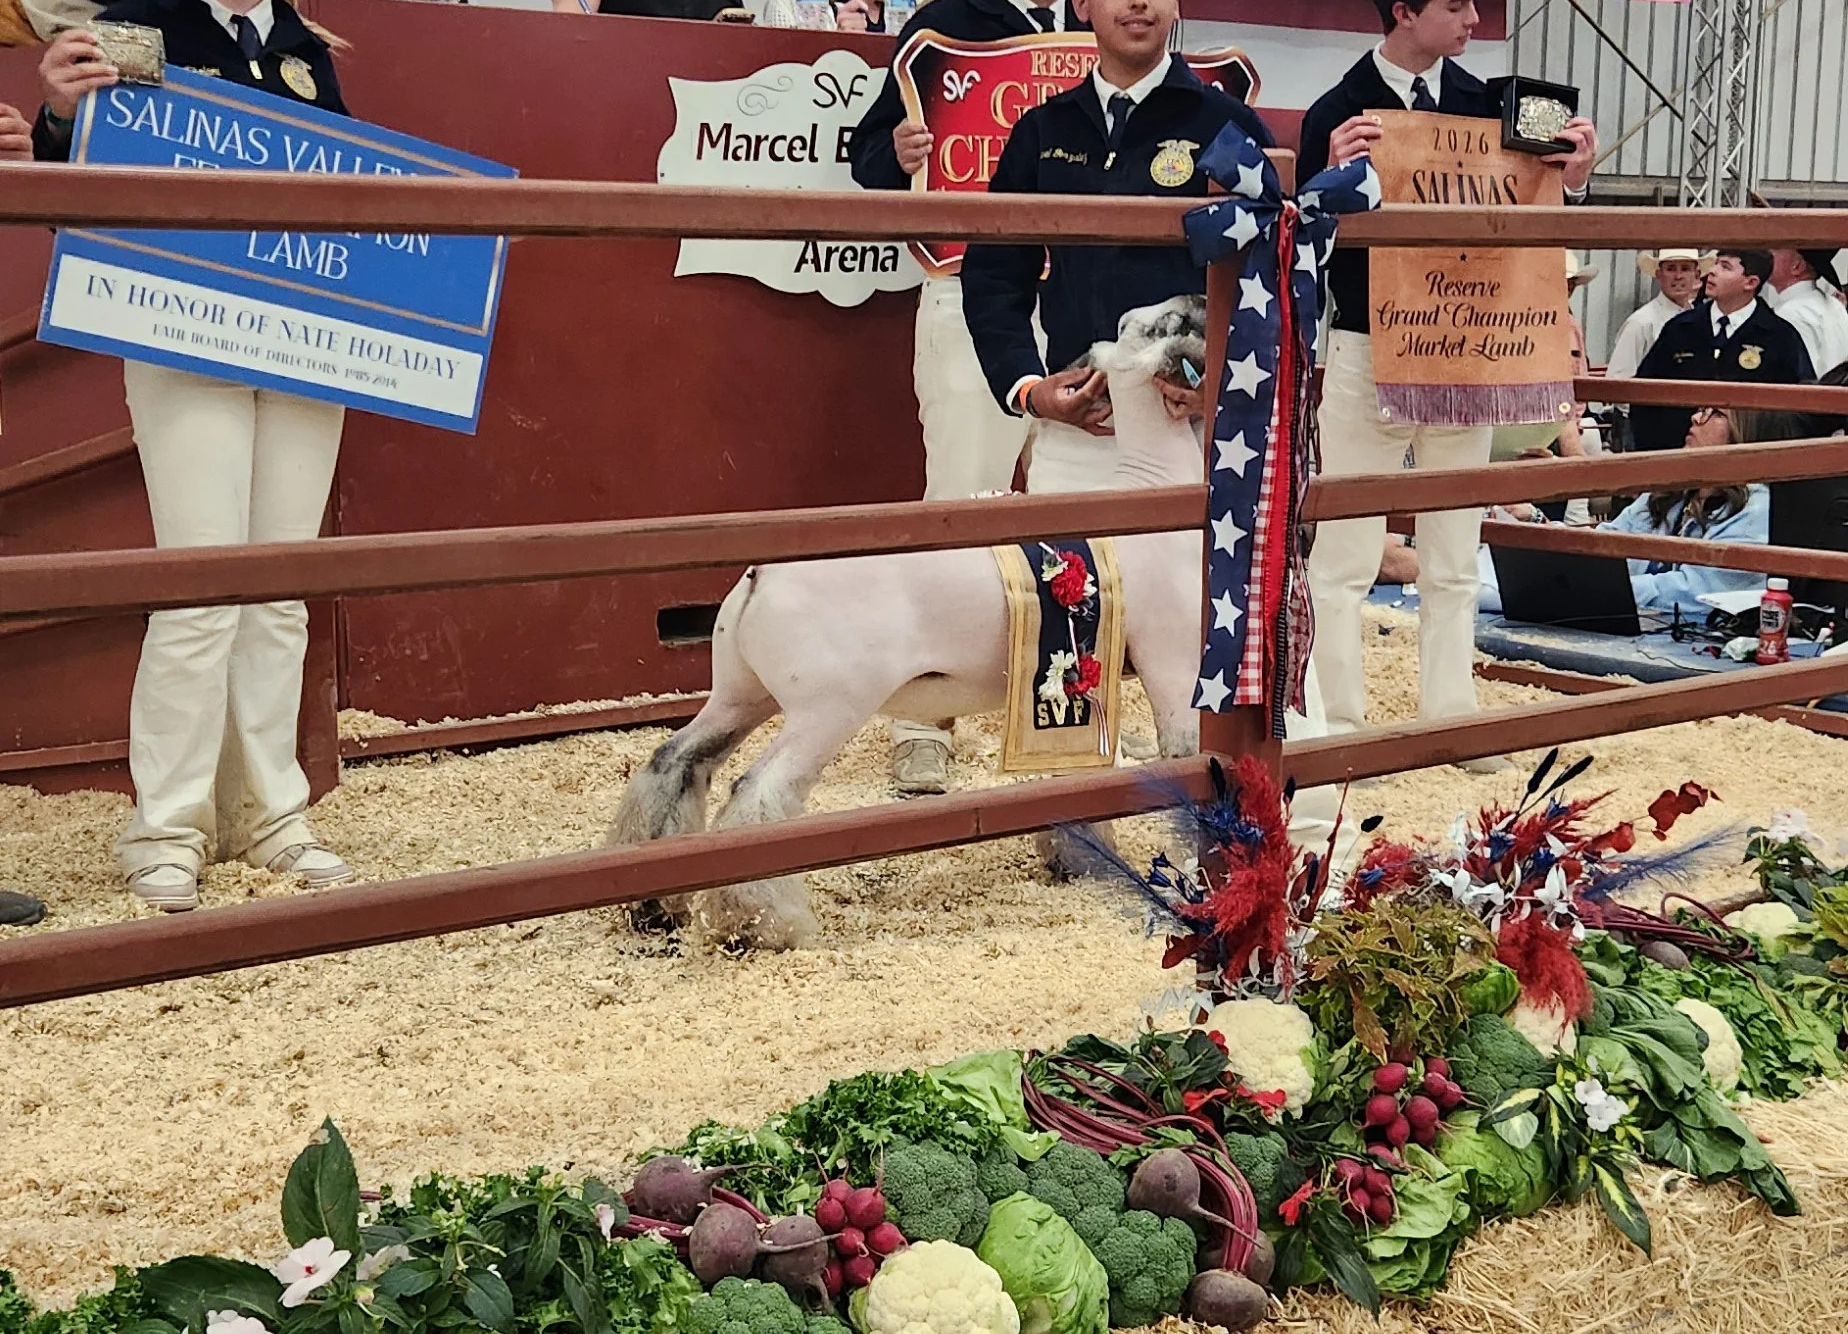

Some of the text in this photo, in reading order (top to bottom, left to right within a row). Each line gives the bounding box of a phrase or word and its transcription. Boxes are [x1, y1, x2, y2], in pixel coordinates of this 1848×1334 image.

[1031, 50, 1101, 78] RESE
[812, 72, 868, 110] SVF
[943, 69, 982, 102] SVF
[106, 88, 272, 165] SALINAS
[696, 122, 819, 163] Marcel
[1432, 126, 1490, 156] 2026
[1411, 168, 1518, 205] SALINAS
[247, 229, 349, 280] LAMB
[793, 240, 900, 273] Arena
[1425, 270, 1501, 298] Reserve
[86, 274, 461, 380] IN HONOR OF NATE HOLADAY
[1376, 299, 1558, 334] Grand Champion
[152, 323, 186, 342] FAIR
[190, 332, 240, 354] BOARD
[243, 343, 263, 359] OF
[265, 349, 339, 376] DIRECTORS
[1396, 331, 1535, 362] Market Lamb
[1037, 698, 1085, 727] SVF
